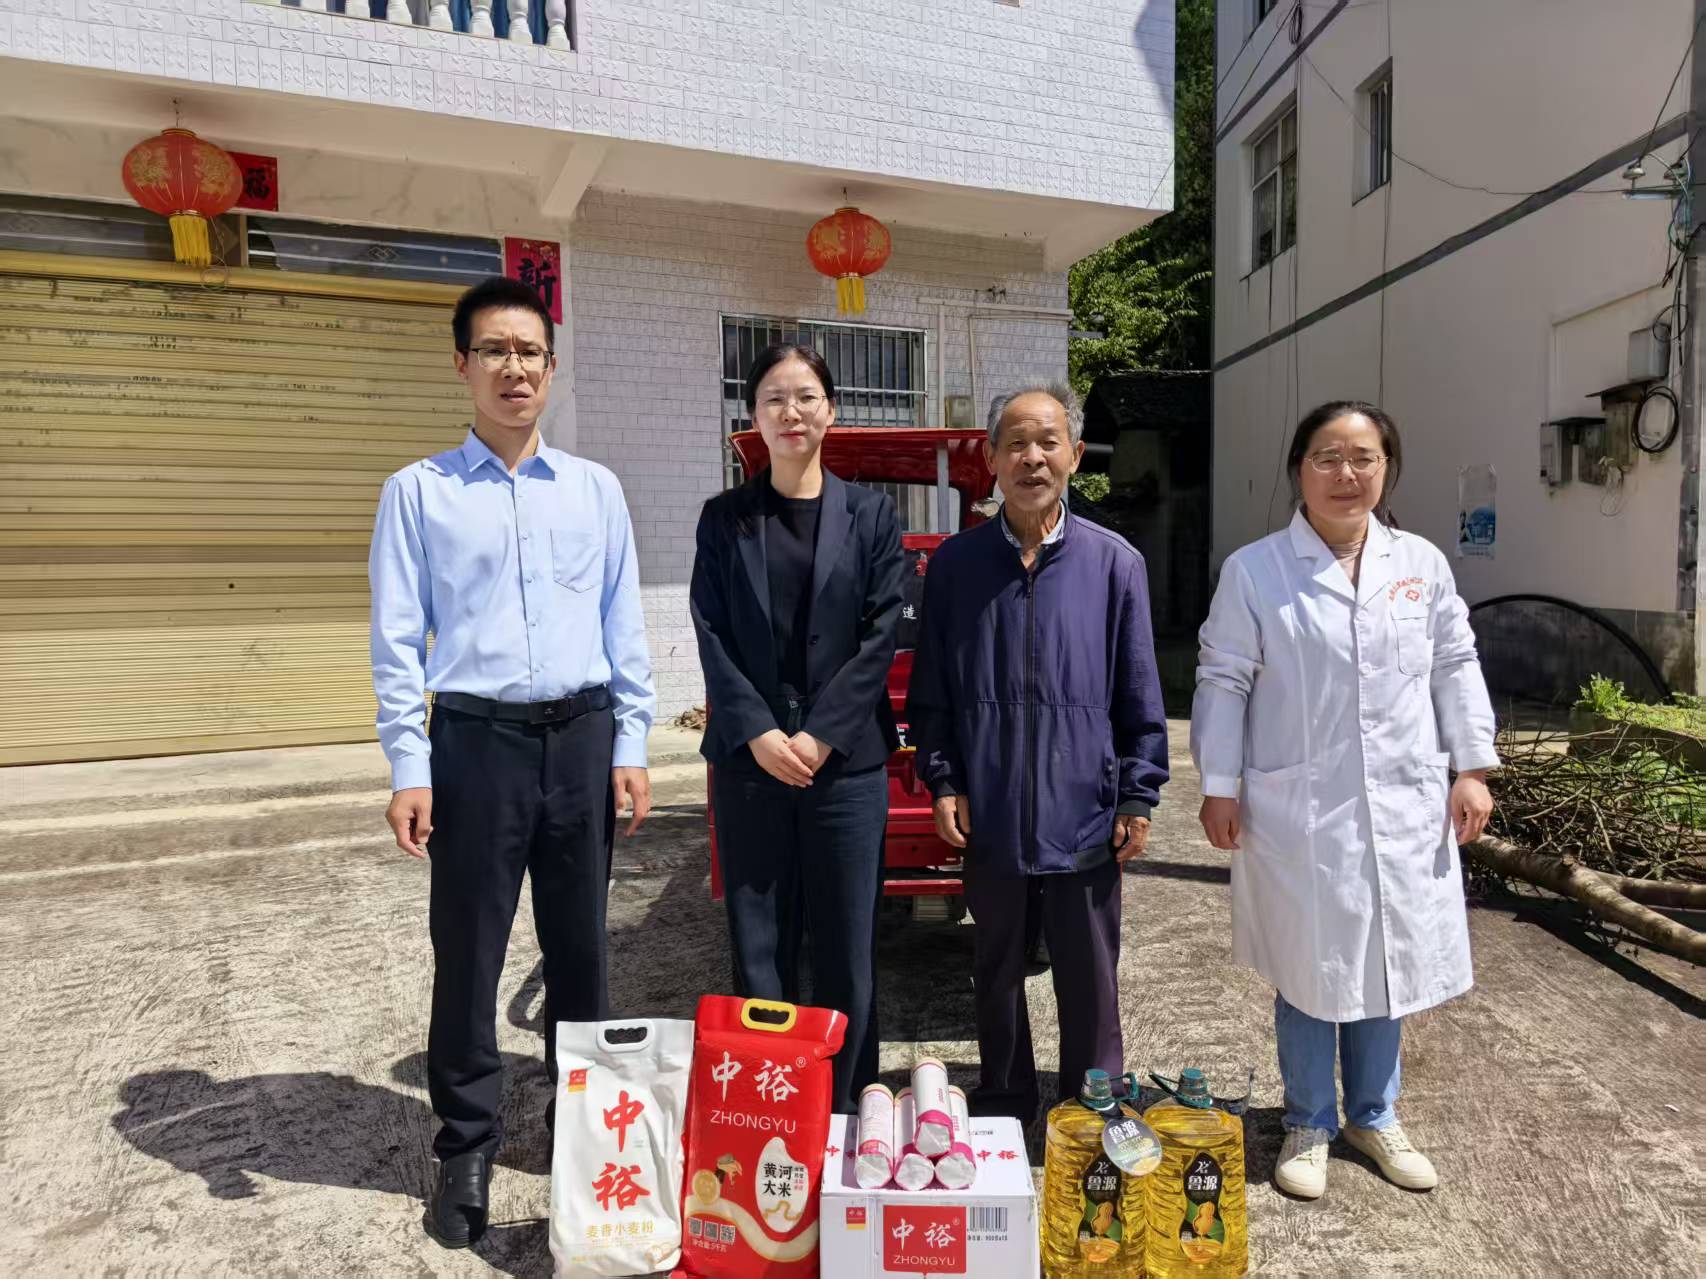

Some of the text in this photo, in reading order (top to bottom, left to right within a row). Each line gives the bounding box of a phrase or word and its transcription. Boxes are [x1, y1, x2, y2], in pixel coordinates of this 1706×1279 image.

[517, 257, 557, 308] 新
[902, 604, 917, 620] 造
[711, 1050, 800, 1104] 中裕
[710, 1109, 796, 1133] ZHONGYU
[591, 1089, 651, 1212] 中裕
[977, 1149, 1019, 1162] 中裕
[763, 1162, 793, 1181] 黄河
[762, 1180, 792, 1198] 大米
[1087, 1175, 1118, 1191] 鲁源
[1187, 1175, 1218, 1191] 鲁源
[891, 1214, 957, 1251] 中裕
[892, 1254, 955, 1266] ZHONGYU
